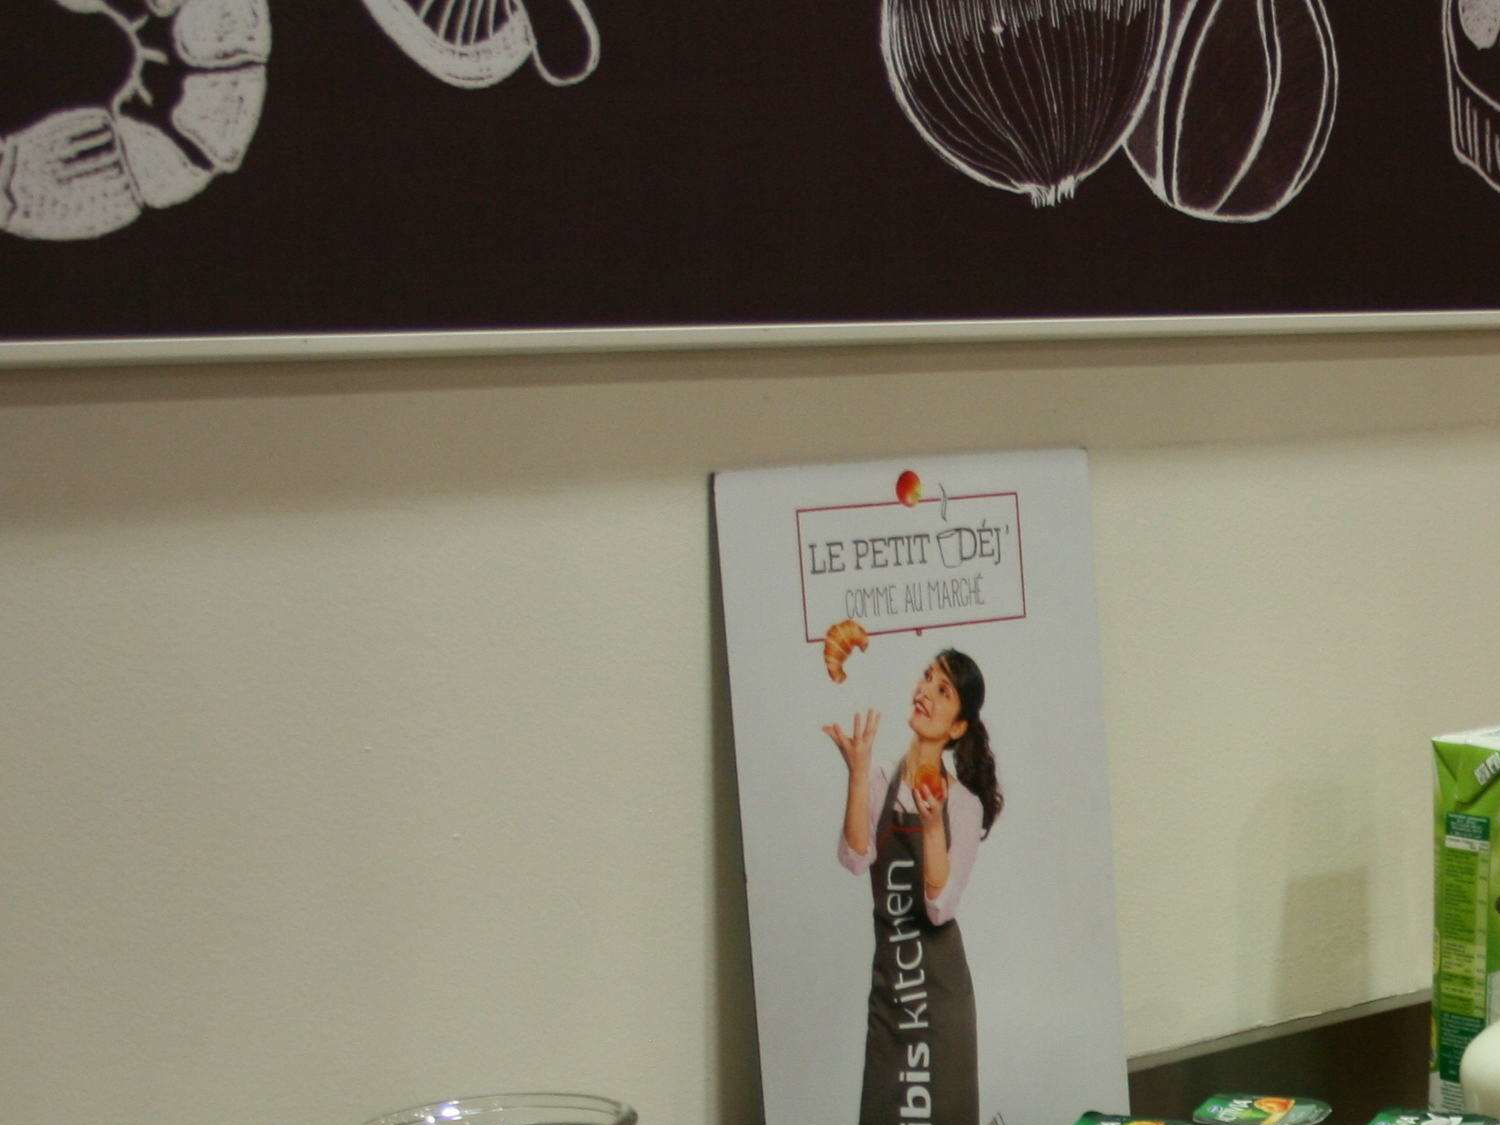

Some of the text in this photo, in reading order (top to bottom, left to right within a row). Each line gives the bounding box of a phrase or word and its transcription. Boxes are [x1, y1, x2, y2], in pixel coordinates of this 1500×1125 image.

[809, 542, 846, 575] LE
[853, 534, 931, 570] PETIT
[846, 572, 986, 619] COMME AU MARCHÉ
[886, 859, 929, 1030] kitchen
